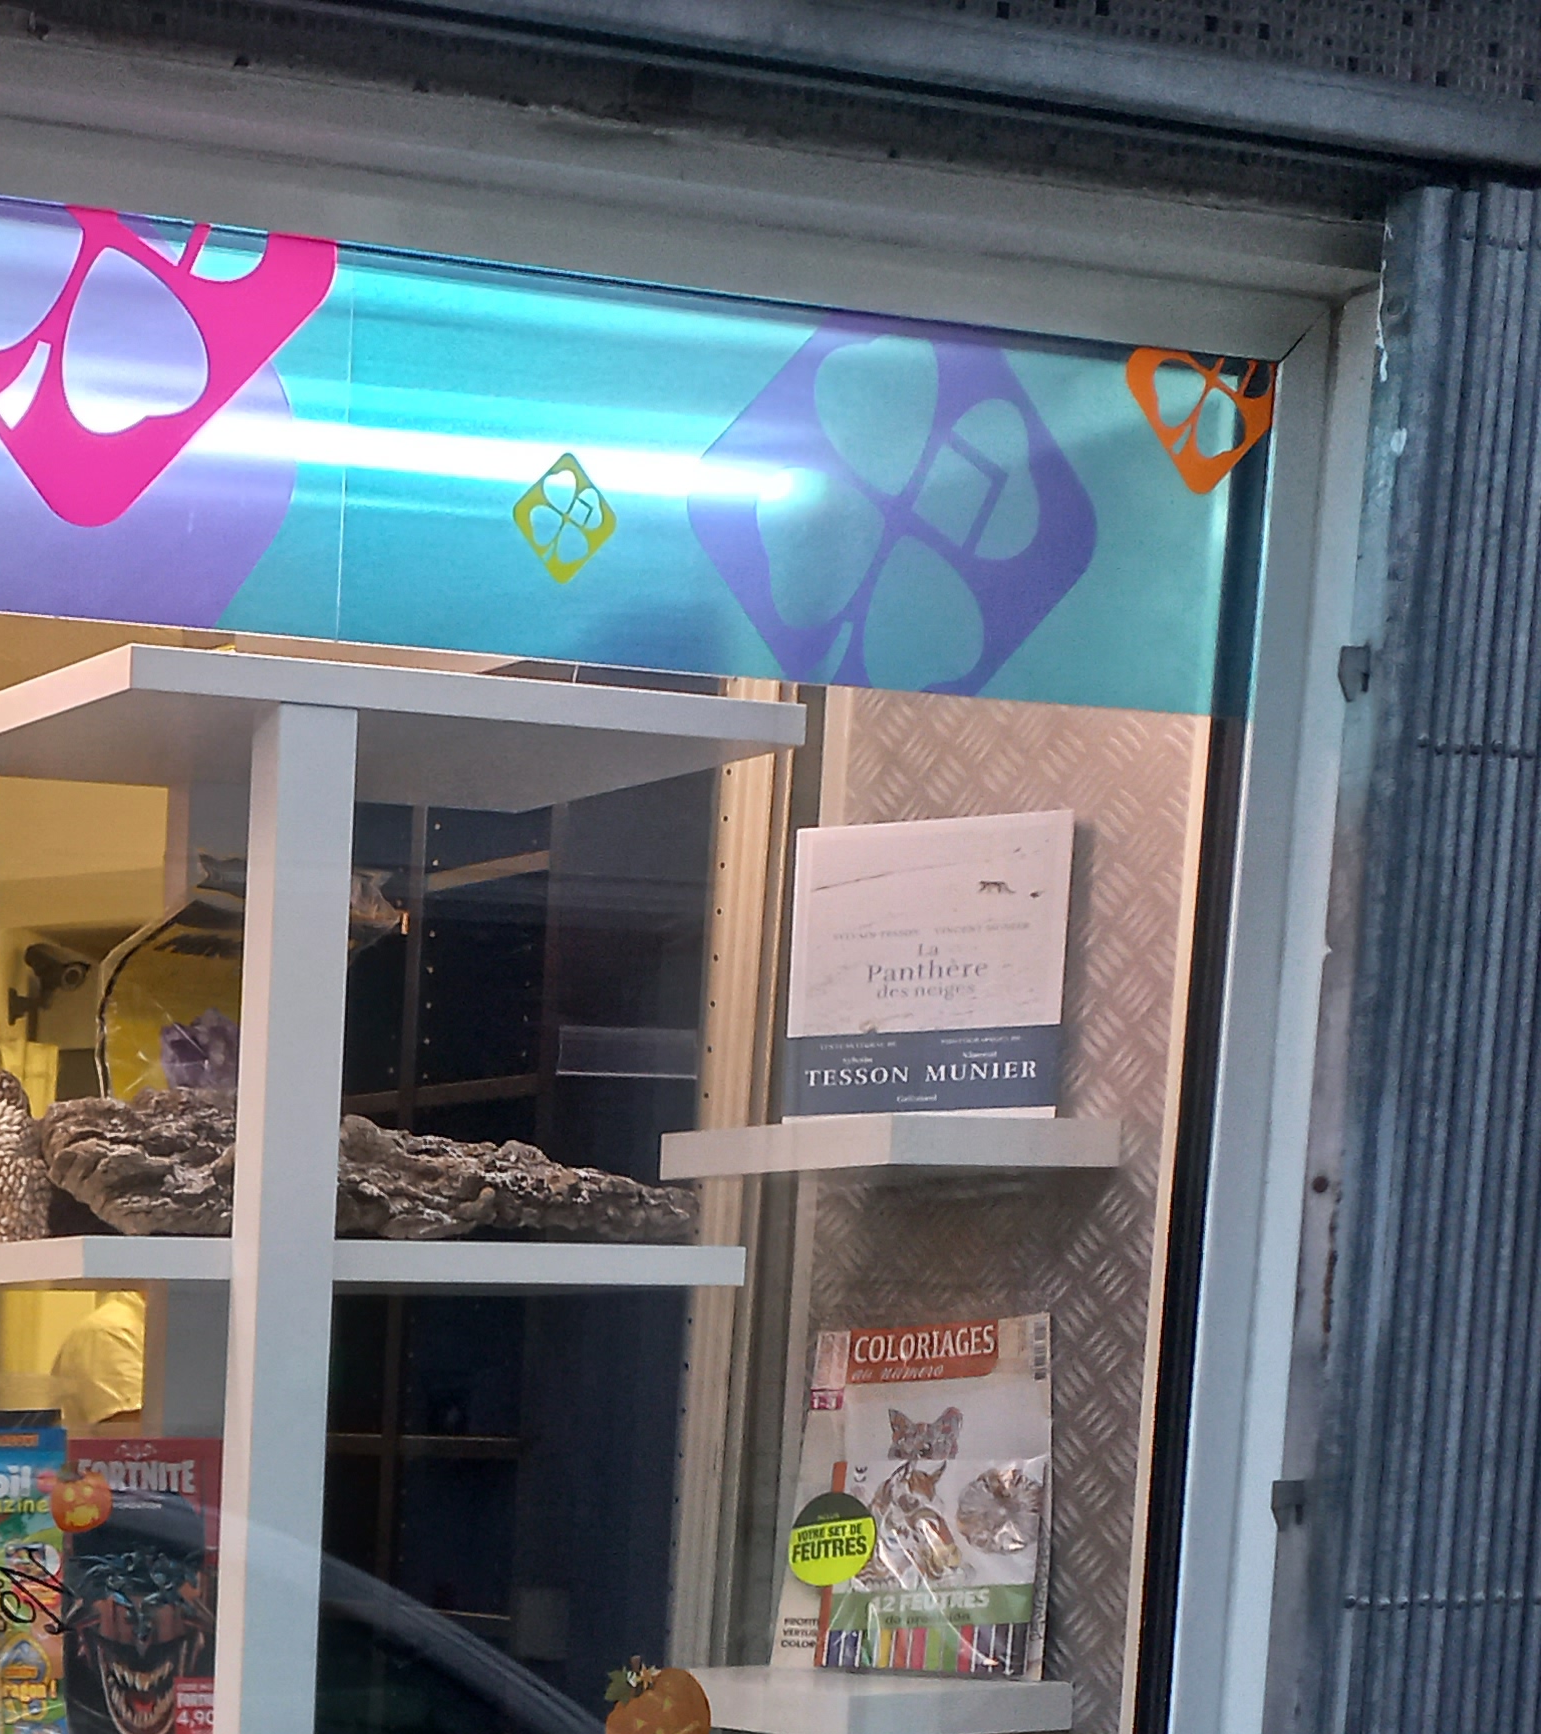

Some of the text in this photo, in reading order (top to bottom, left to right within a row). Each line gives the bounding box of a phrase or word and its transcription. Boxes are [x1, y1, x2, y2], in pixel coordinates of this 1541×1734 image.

[918, 943, 939, 957] La
[867, 958, 989, 983] Panthère
[876, 982, 976, 1001] des neiges
[805, 1060, 1038, 1088] TESSON MUNIER
[853, 1324, 997, 1365] COLORIAGES
[827, 1524, 847, 1540] SET
[848, 1523, 863, 1536] DE
[791, 1537, 869, 1565] FEUTRES
